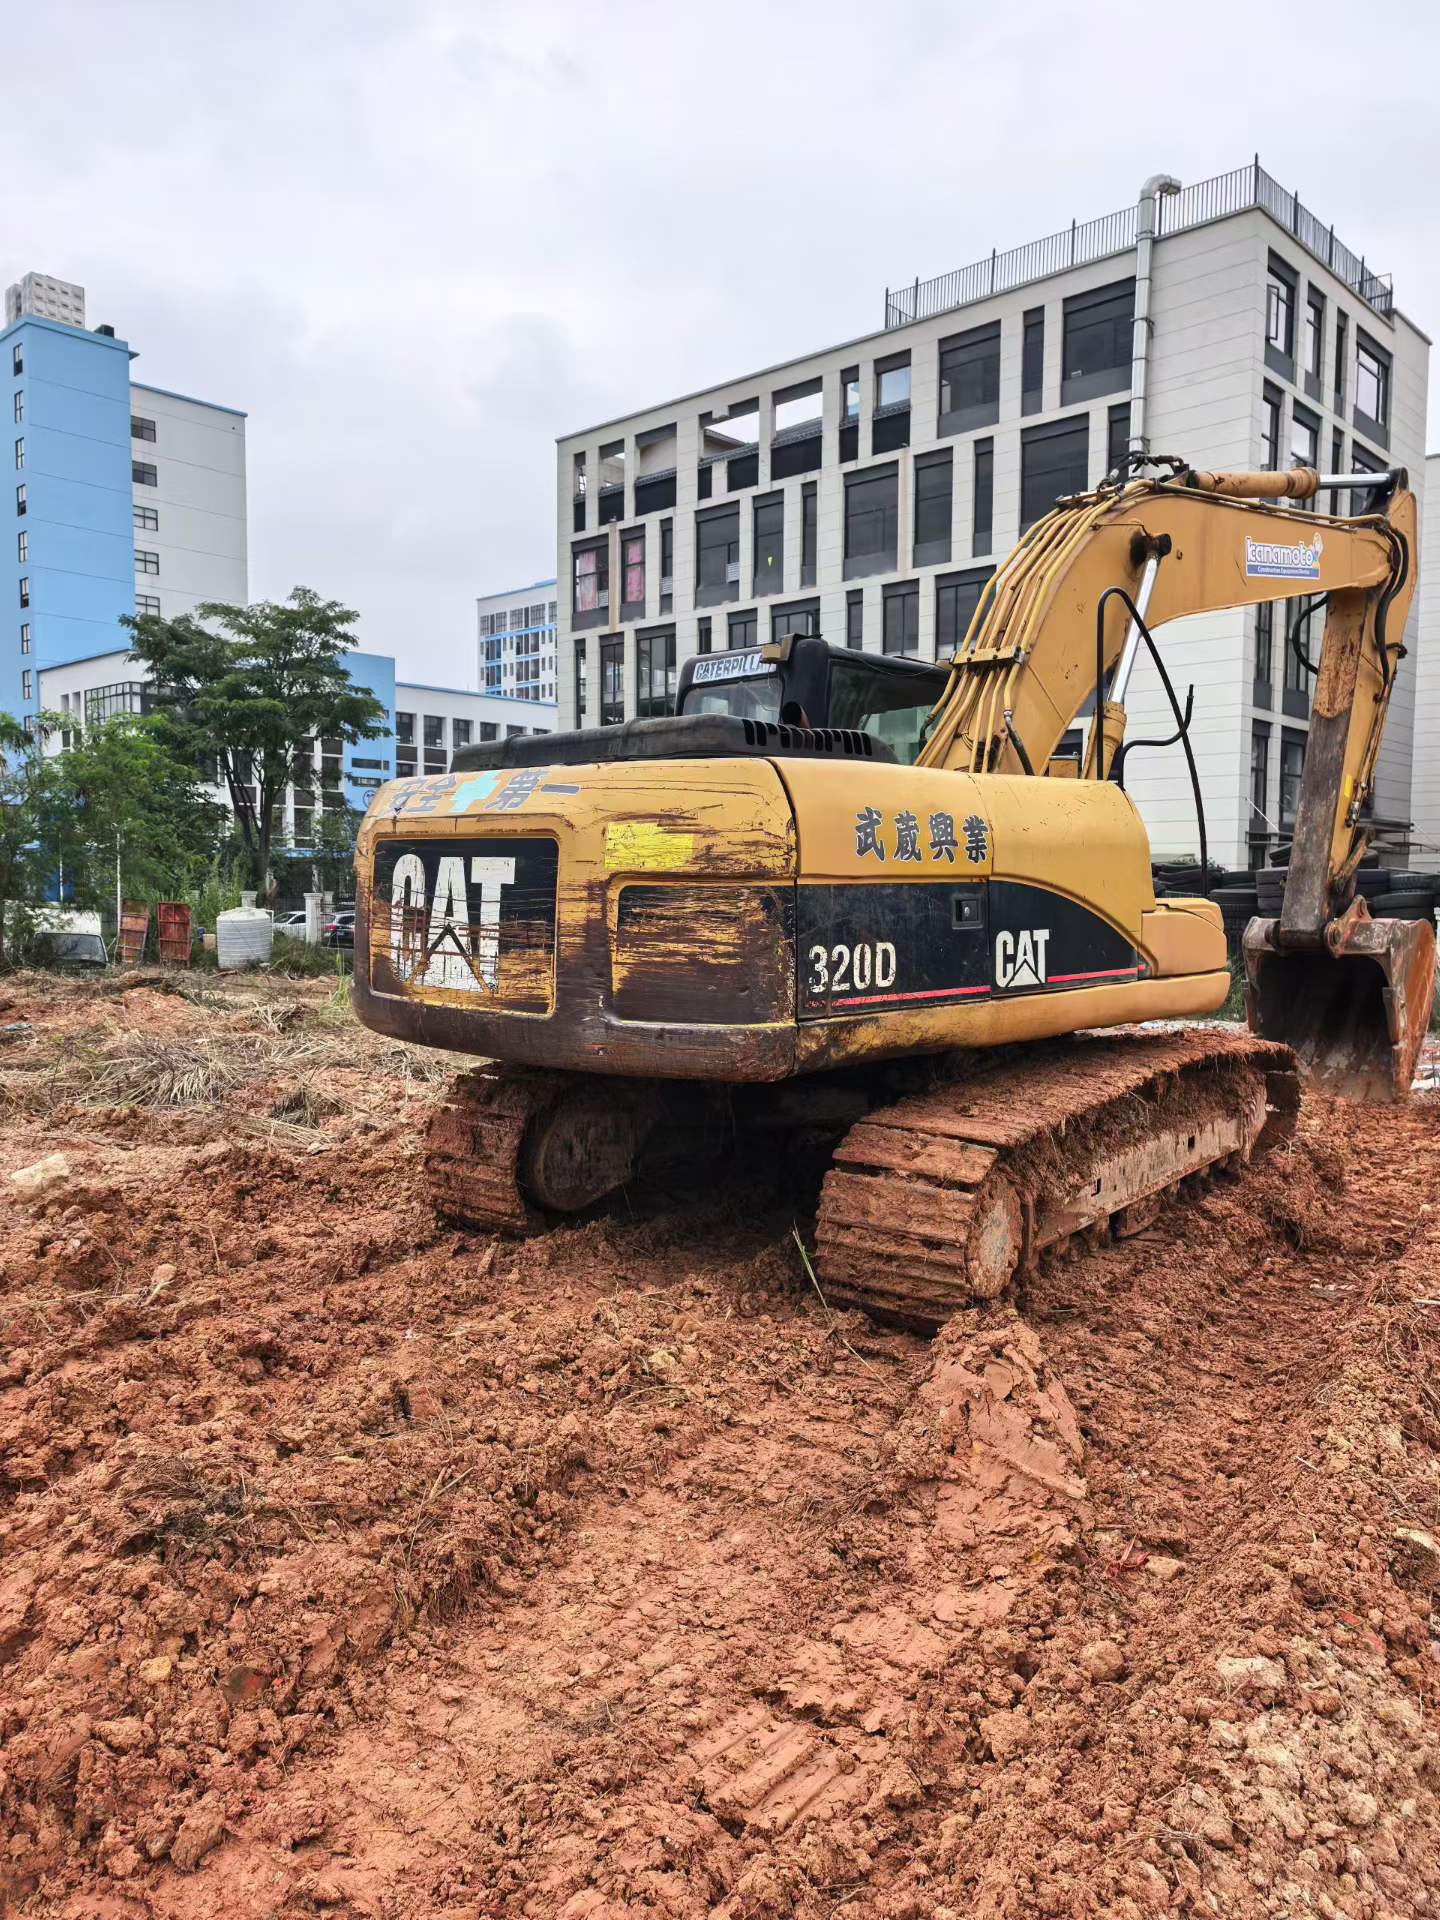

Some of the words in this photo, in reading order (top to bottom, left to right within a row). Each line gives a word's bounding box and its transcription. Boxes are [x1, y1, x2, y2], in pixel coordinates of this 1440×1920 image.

[1246, 537, 1313, 566] kanamoto
[390, 853, 516, 993] CAT
[808, 942, 897, 994] 320D
[995, 929, 1050, 988] CAT
